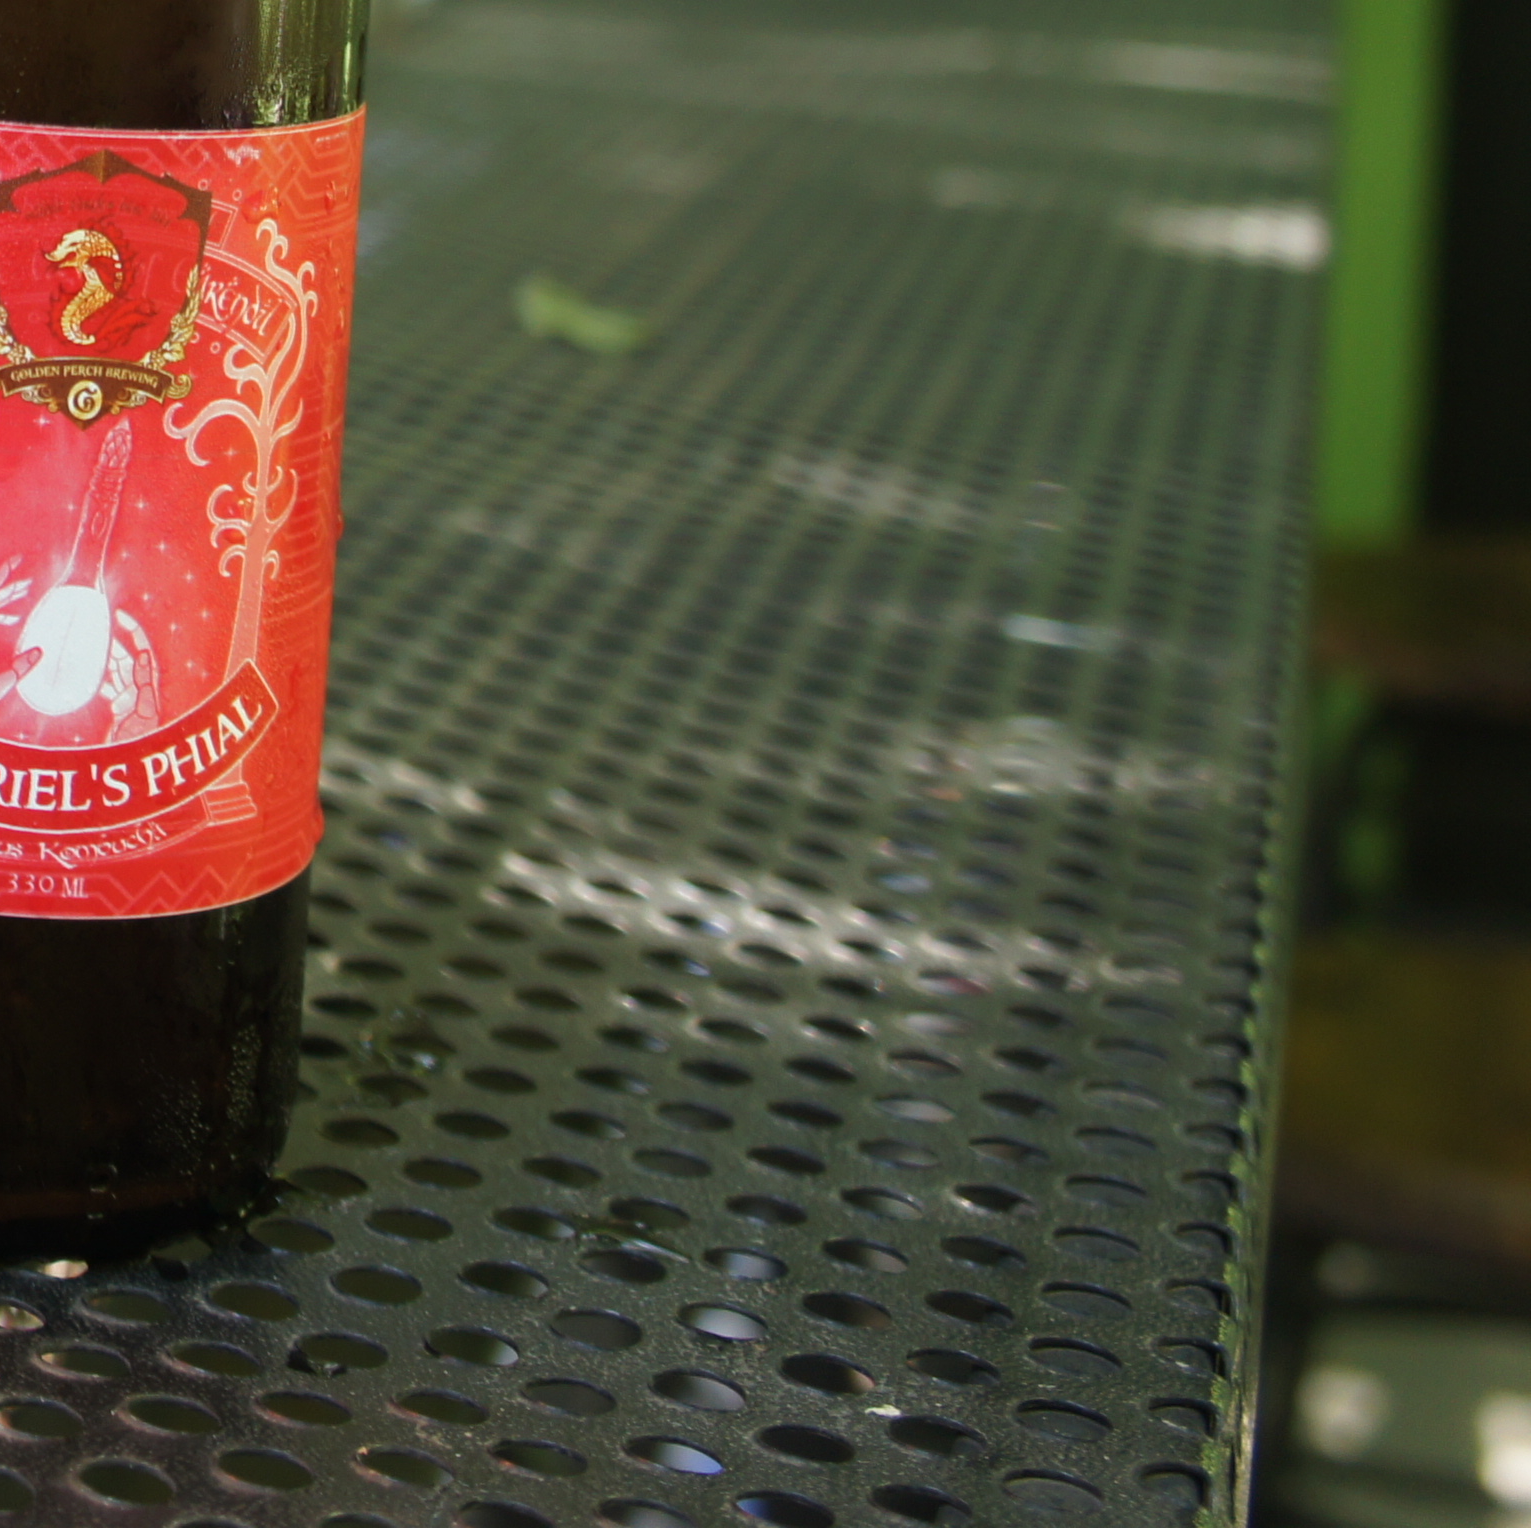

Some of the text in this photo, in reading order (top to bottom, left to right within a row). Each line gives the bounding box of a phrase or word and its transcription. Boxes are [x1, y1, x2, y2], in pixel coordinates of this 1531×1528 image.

[10, 364, 159, 389] GOLDEN PERCH BREWING
[142, 695, 264, 797] PHIAL
[8, 873, 89, 899] 330 ML
